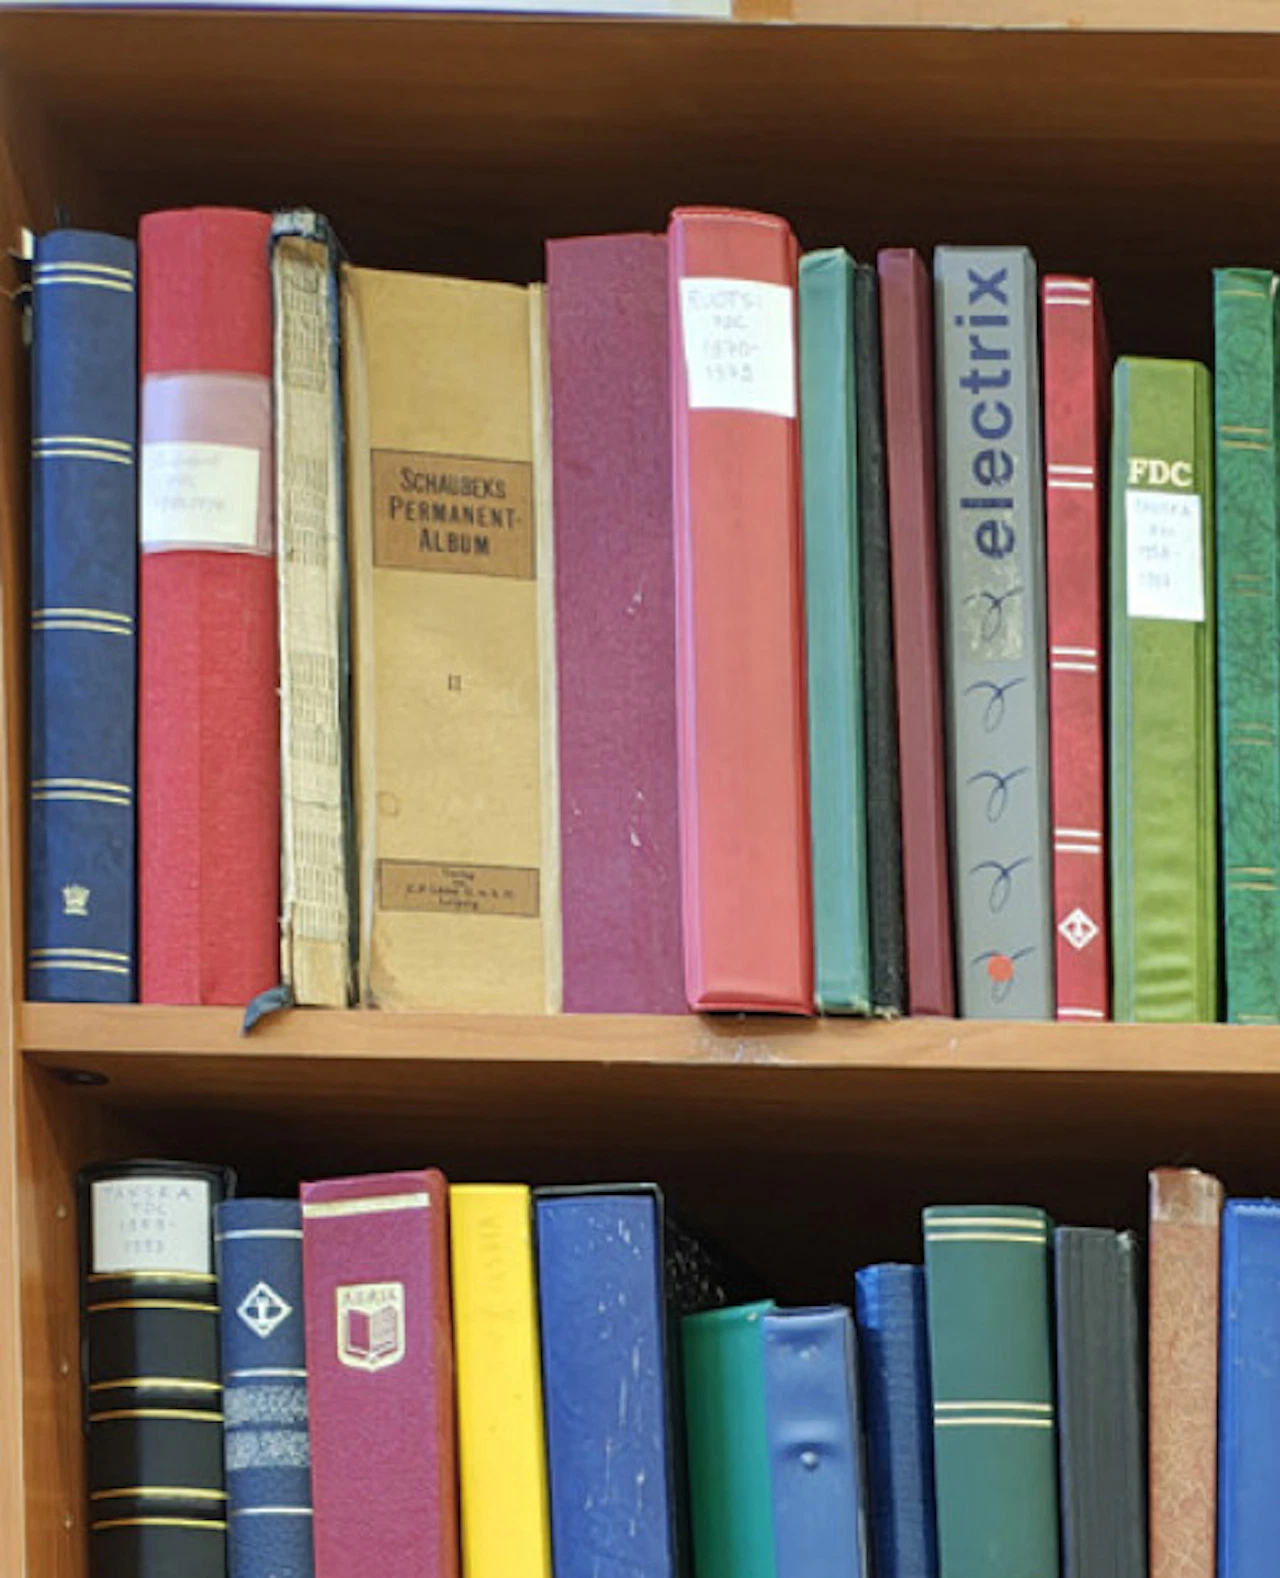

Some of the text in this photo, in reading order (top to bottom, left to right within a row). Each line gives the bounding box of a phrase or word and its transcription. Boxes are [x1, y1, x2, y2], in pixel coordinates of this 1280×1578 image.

[955, 265, 1016, 560] electrix
[400, 466, 507, 499] SCHAUBEKS
[1127, 458, 1193, 487] FDC
[419, 527, 490, 555] ALBUM
